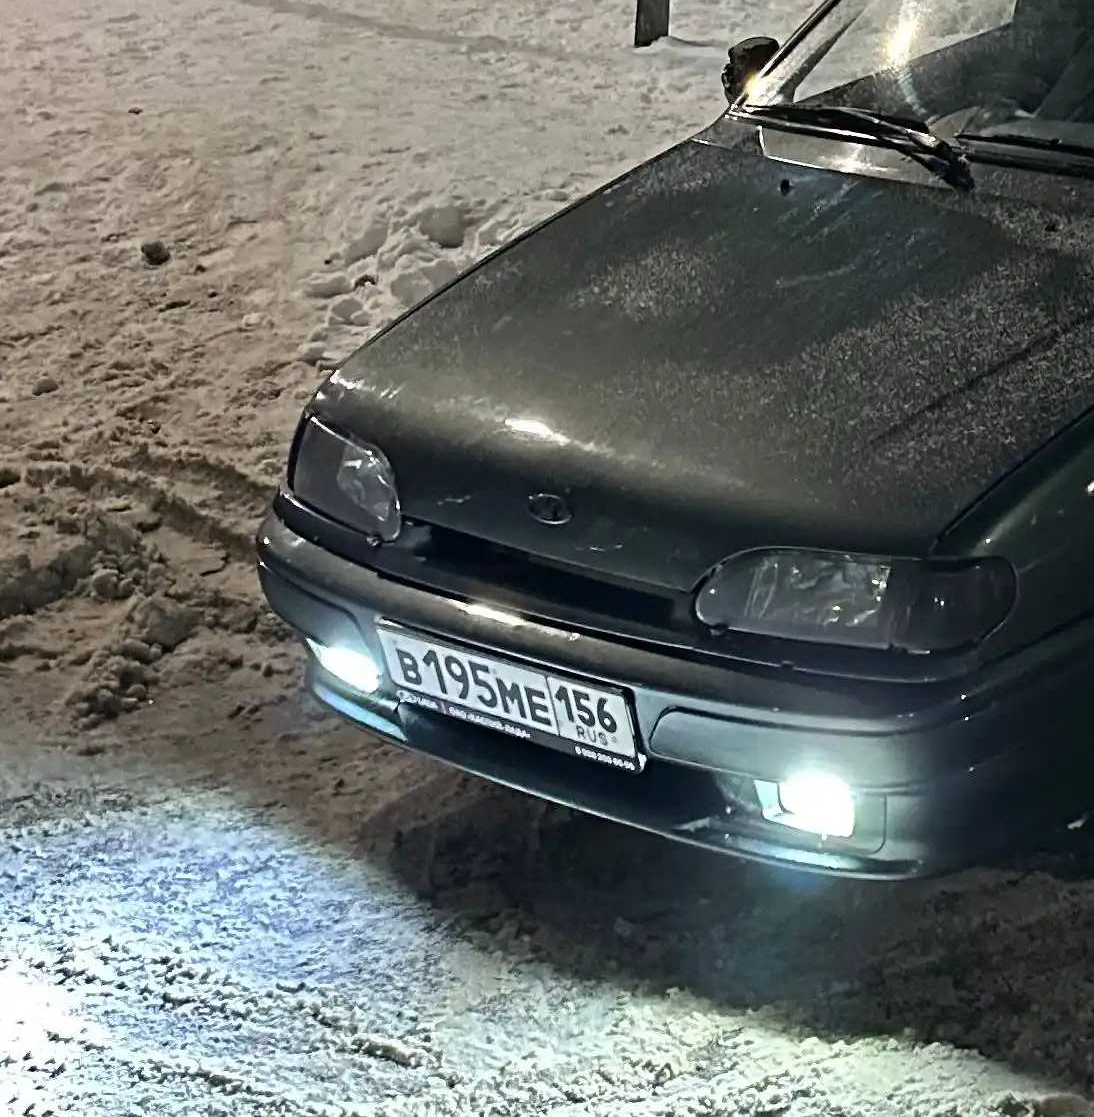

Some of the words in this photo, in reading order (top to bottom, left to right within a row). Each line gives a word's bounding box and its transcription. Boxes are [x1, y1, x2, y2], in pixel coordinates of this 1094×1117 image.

[396, 649, 553, 727] В195МЕ
[555, 685, 618, 734] 156
[576, 725, 608, 746] RUS
